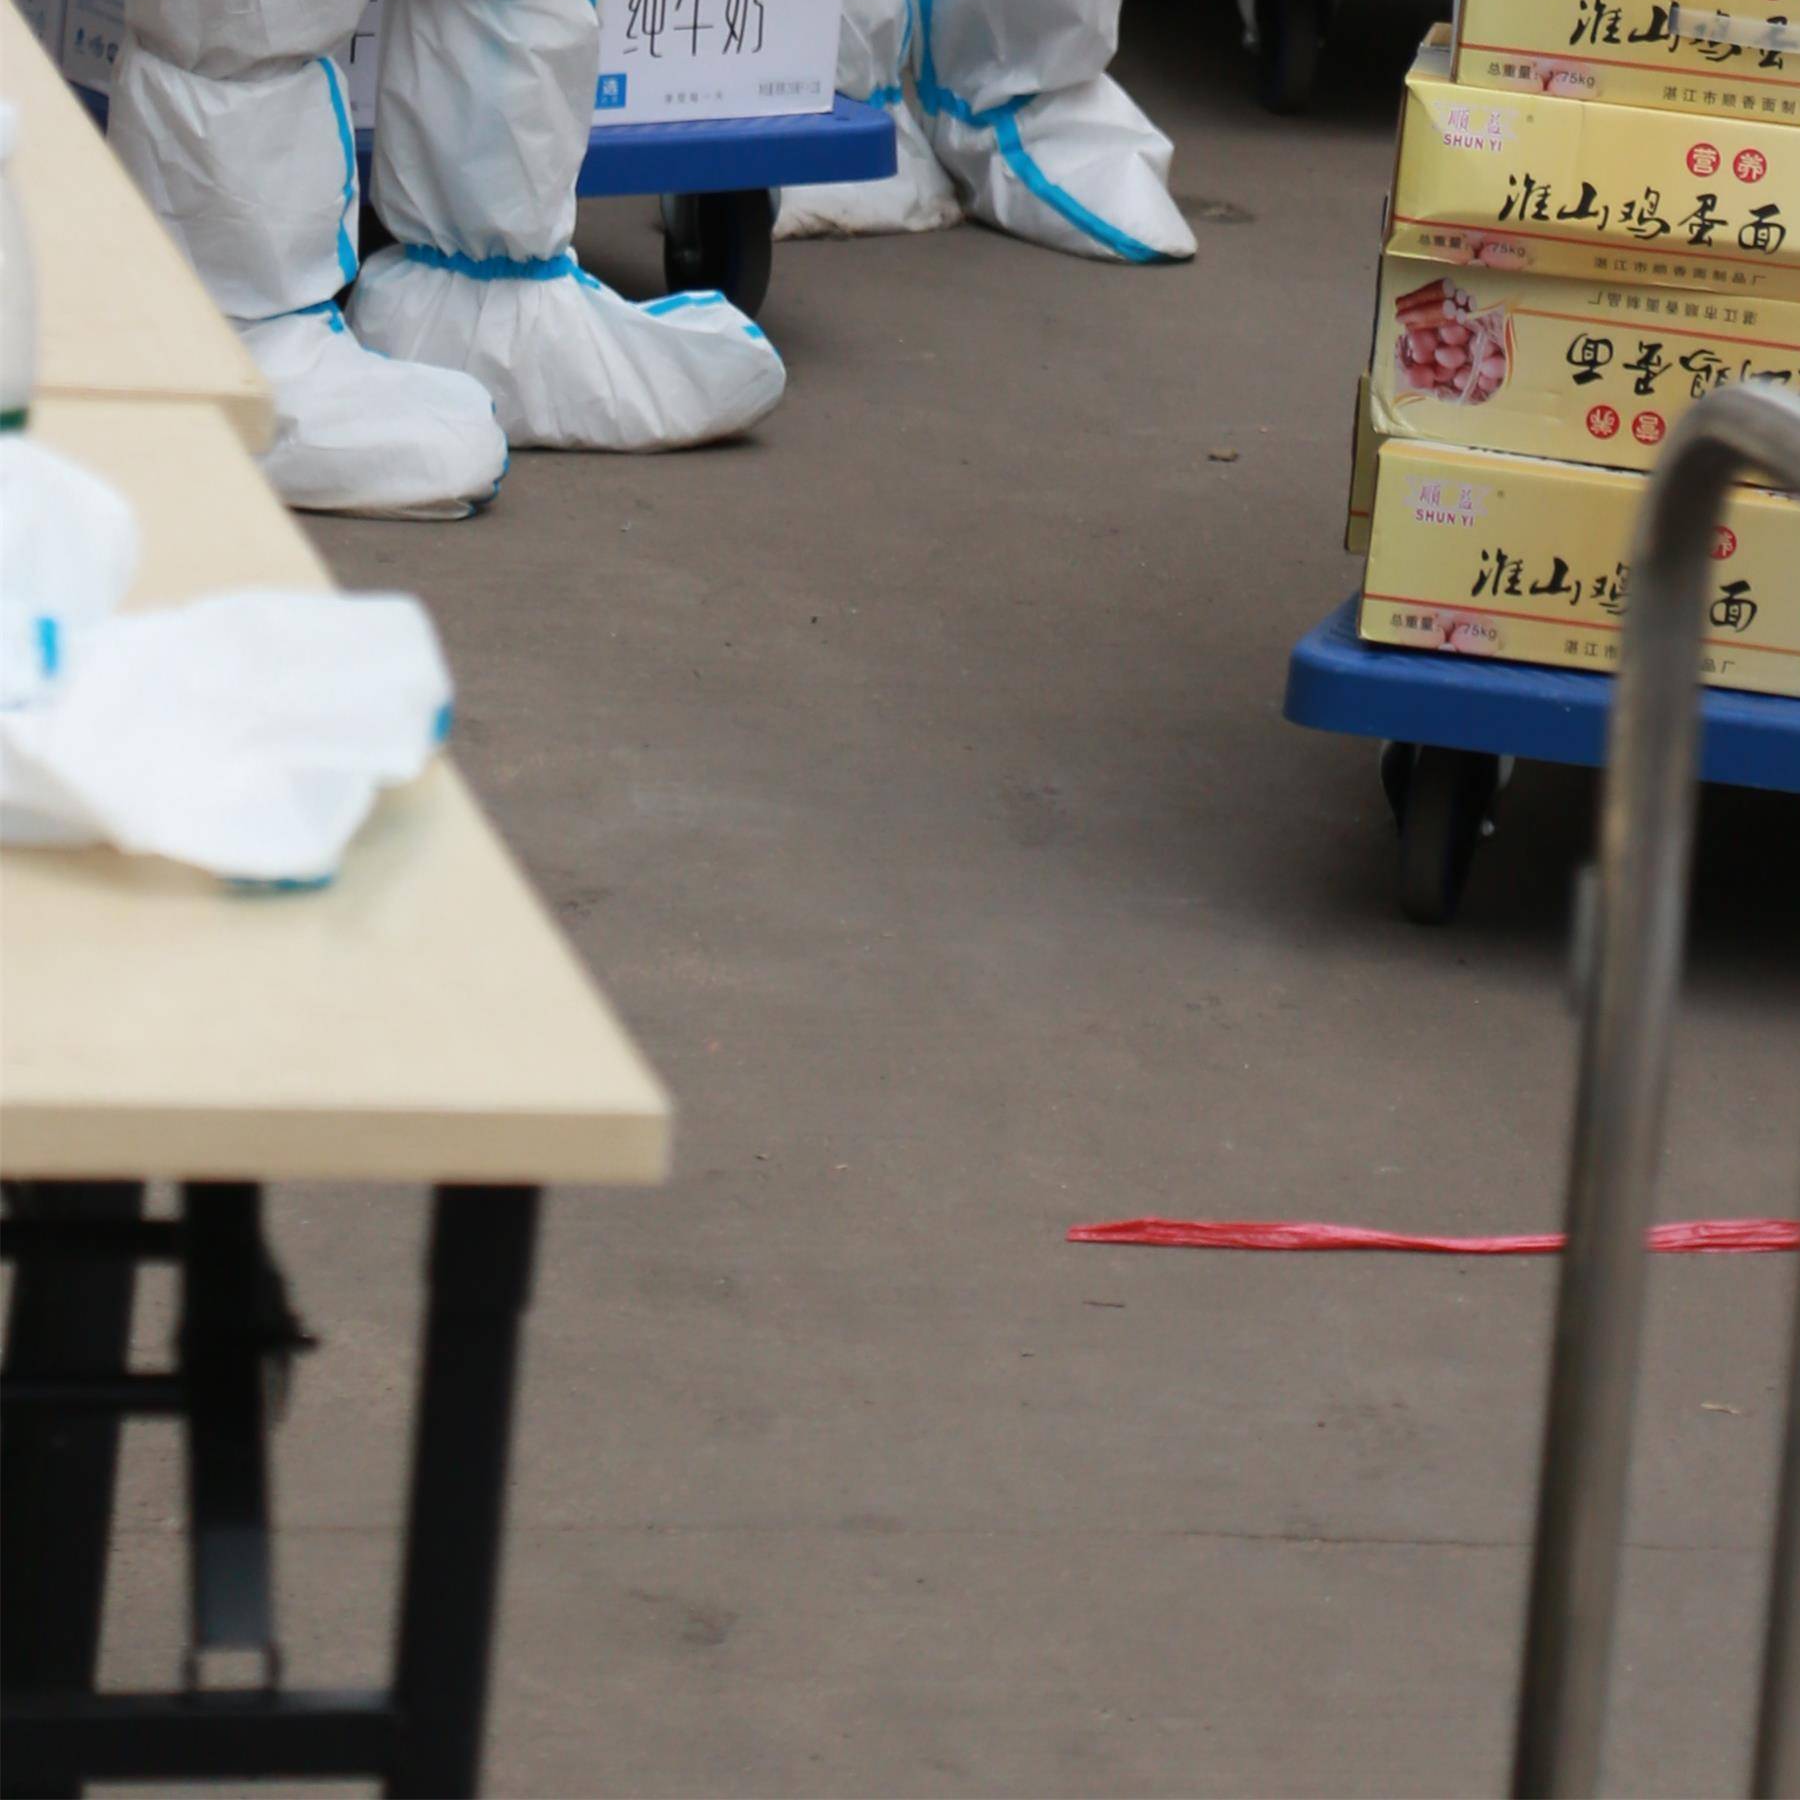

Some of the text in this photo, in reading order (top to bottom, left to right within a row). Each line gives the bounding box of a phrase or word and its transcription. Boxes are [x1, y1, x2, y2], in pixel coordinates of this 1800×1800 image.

[1443, 133, 1503, 152] SHUN YI
[1686, 142, 1768, 184] 营养
[1498, 173, 1787, 254] 淮山鸡蛋面
[1415, 508, 1476, 527] SHUN YI
